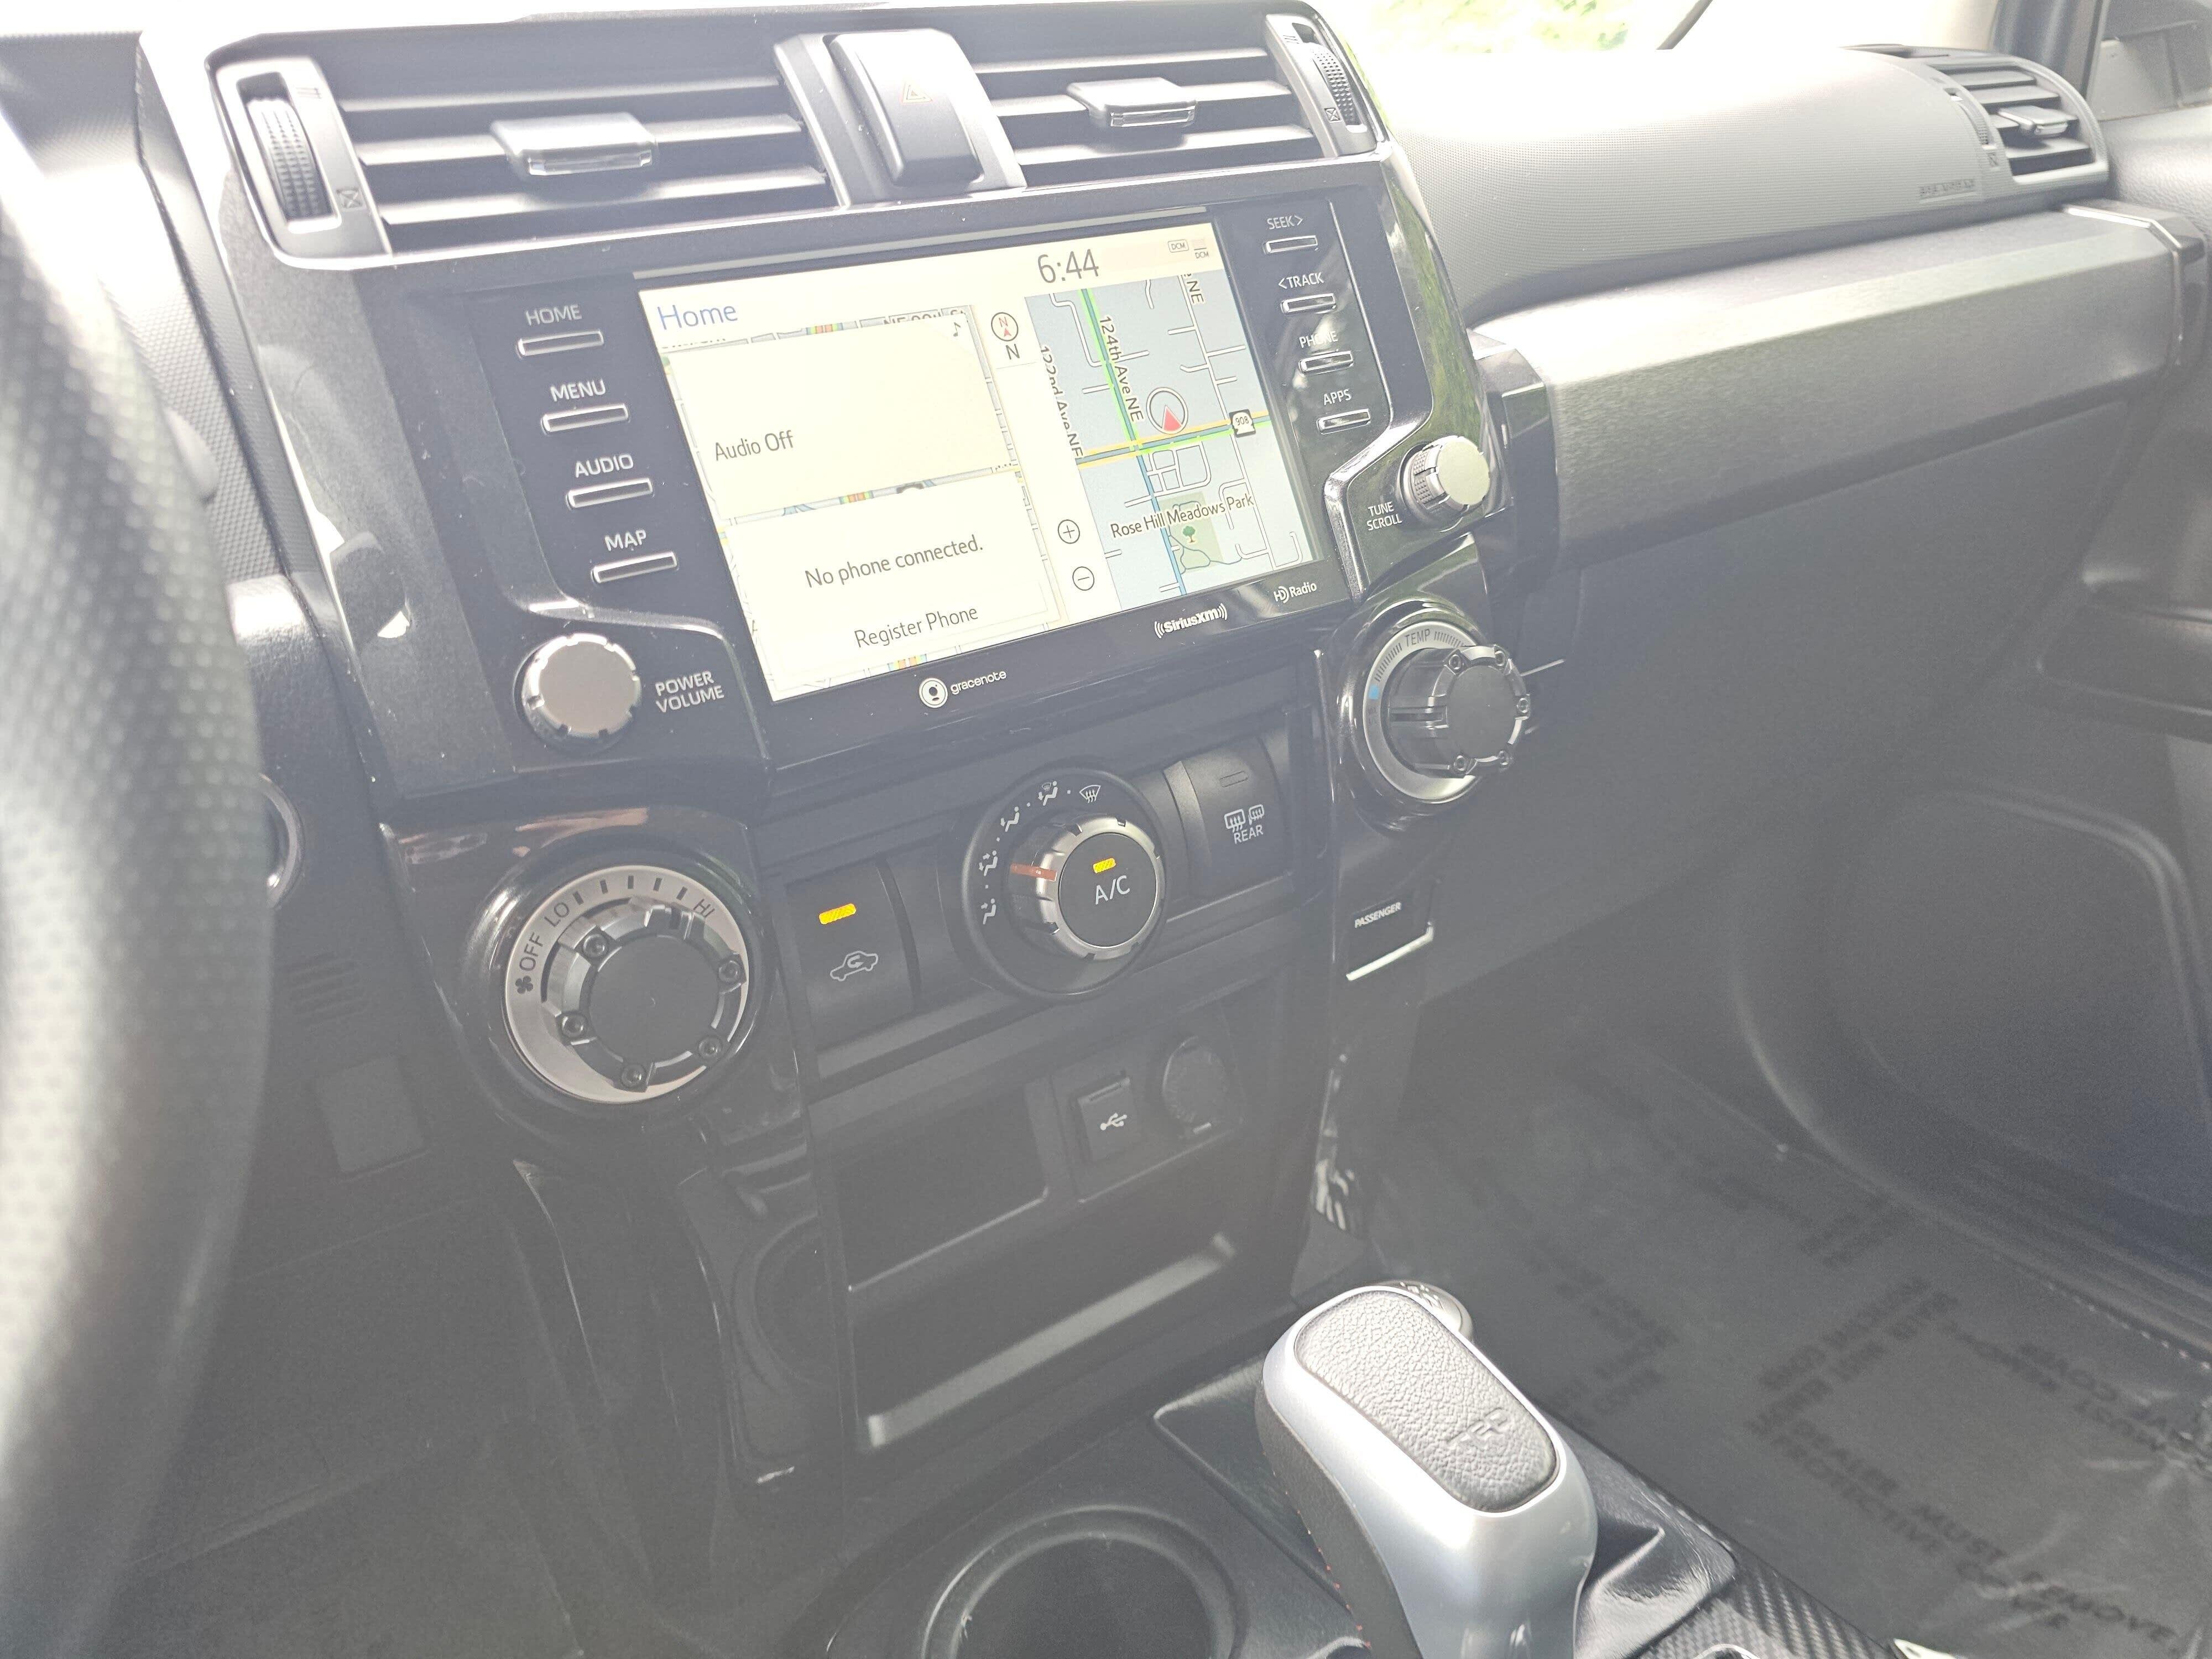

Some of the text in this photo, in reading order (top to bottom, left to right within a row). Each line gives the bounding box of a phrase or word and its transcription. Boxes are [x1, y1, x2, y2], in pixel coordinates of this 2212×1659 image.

[1037, 248, 1099, 284] 6:44
[1186, 280, 1204, 304] NE
[1286, 272, 1325, 289] TRACK
[525, 304, 582, 326] HOME
[656, 304, 739, 331] Home
[998, 316, 1009, 328] N
[1005, 343, 1021, 360] N
[1099, 315, 1145, 422] 124th Ave NE
[550, 379, 606, 403] MENU
[1323, 389, 1353, 406] APPS
[1234, 416, 1250, 426] 908
[714, 430, 795, 462] Audio Off
[575, 453, 634, 478] AUDIO
[1110, 493, 1254, 539] Rose Hill Meadows Park
[1368, 500, 1394, 517] TUNE
[1366, 514, 1403, 531] SCROLL
[605, 529, 647, 552] MAP
[805, 534, 984, 588] No phone connected.
[1288, 581, 1317, 598] Radio
[854, 606, 979, 648] Register Phone
[1405, 628, 1432, 649] TEMP
[655, 671, 714, 696] POWER
[950, 670, 1007, 695] gracenote
[655, 685, 725, 713] VOLUME
[1233, 824, 1265, 844] REAR
[1093, 874, 1131, 905] A/C
[1354, 901, 1402, 928] PASSENGER
[519, 898, 716, 972] OFF LO HI
